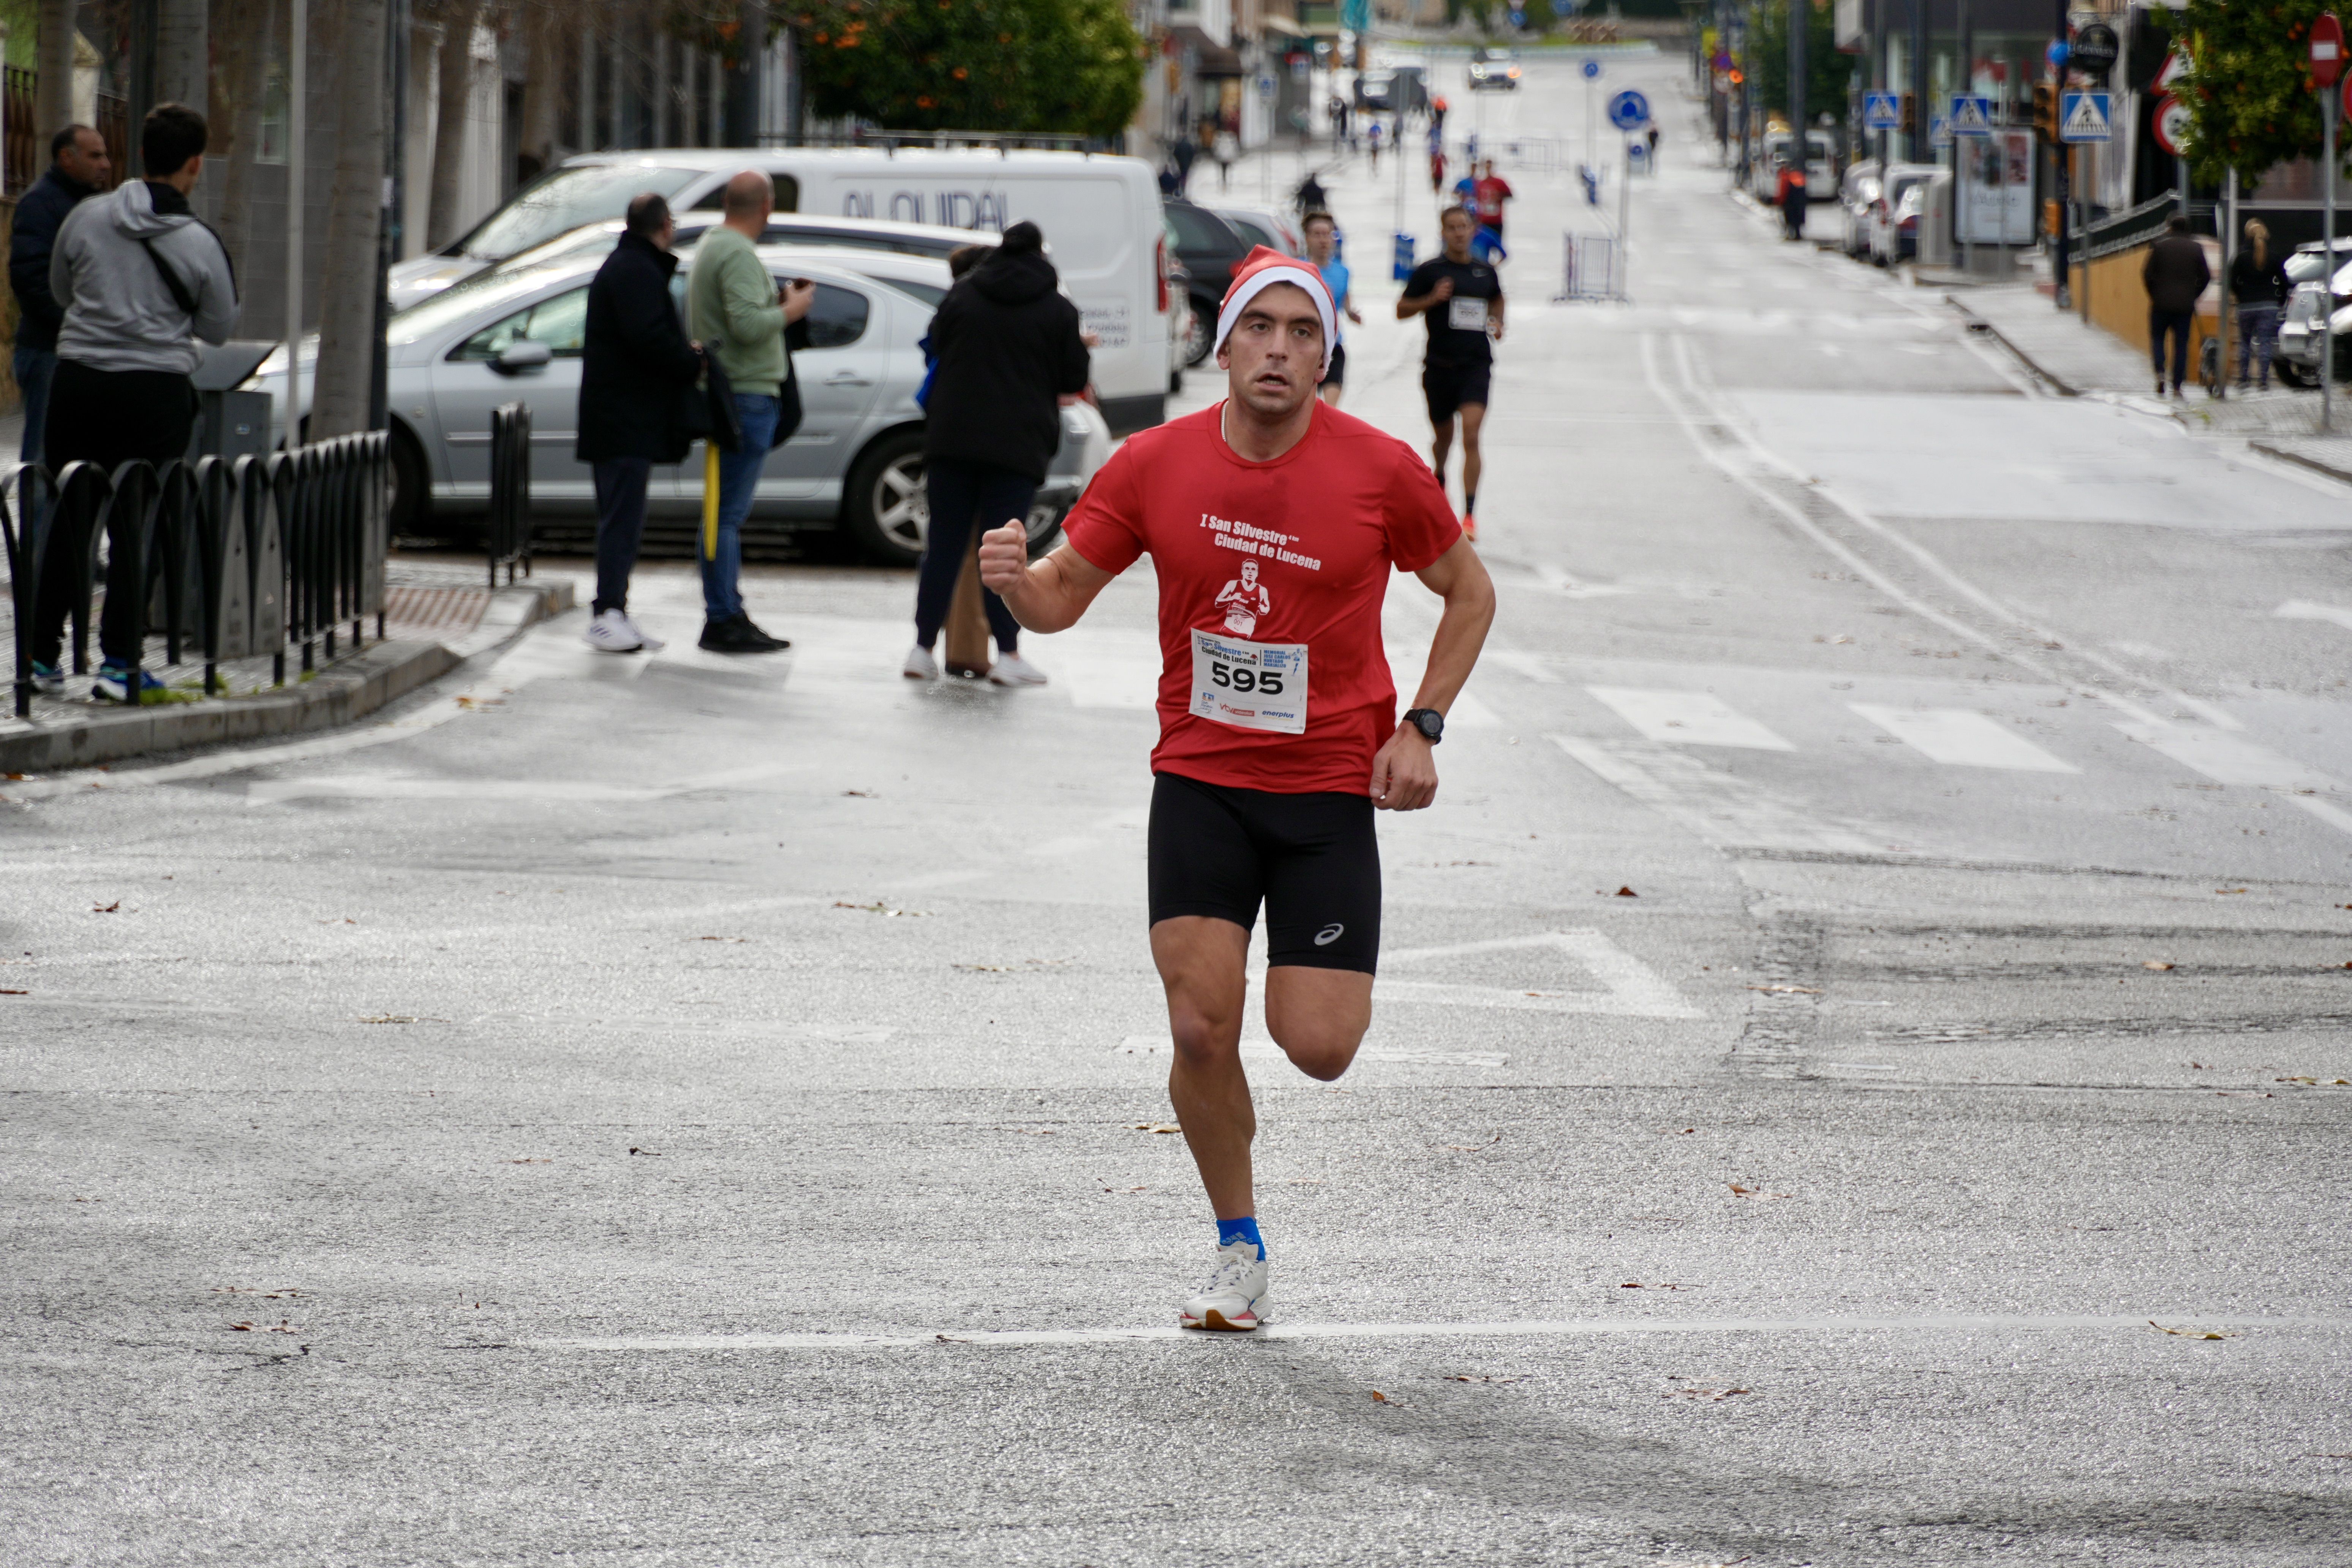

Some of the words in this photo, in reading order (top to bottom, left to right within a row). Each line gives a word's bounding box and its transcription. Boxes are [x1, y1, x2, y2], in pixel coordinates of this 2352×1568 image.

[1200, 514, 1208, 527] I
[1208, 515, 1231, 532] San
[1233, 521, 1287, 545] Silvestre
[1214, 533, 1258, 554] Ciudad
[1259, 544, 1275, 558] de
[1276, 547, 1321, 571] Lucena
[1202, 646, 1222, 658] Ciudad
[1231, 655, 1256, 665] Lucena
[1214, 643, 1241, 656] Silvestre
[1212, 661, 1283, 695] 595
